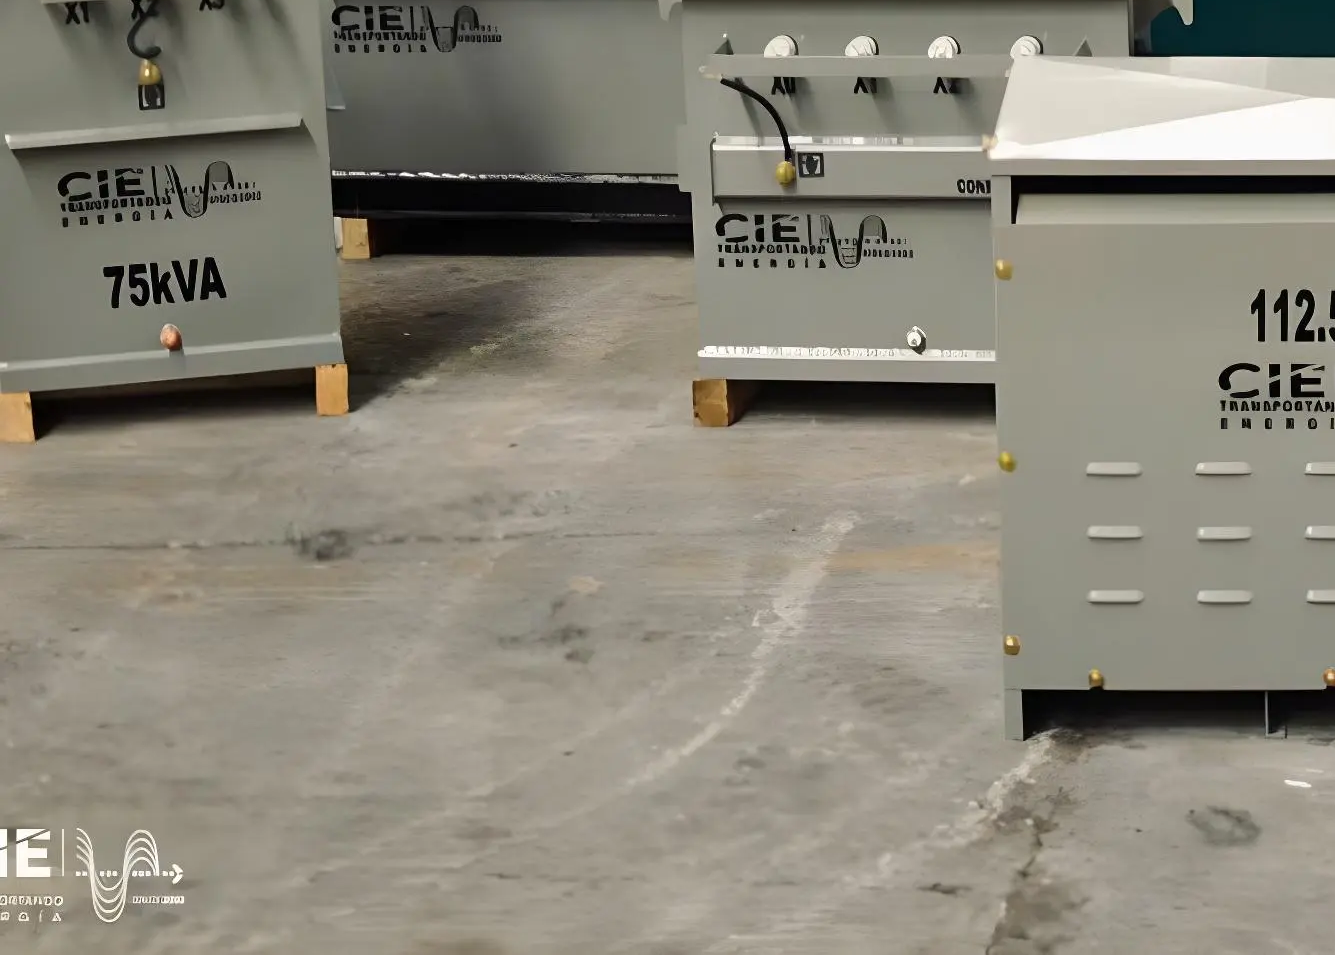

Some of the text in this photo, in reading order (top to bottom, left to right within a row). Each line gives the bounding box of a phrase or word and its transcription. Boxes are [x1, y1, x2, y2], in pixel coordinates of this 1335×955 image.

[331, 4, 404, 32] CIE
[57, 168, 145, 202] CIE
[715, 213, 801, 244] CIE
[102, 256, 227, 309] 75kVA
[1217, 362, 1326, 399] CIE
